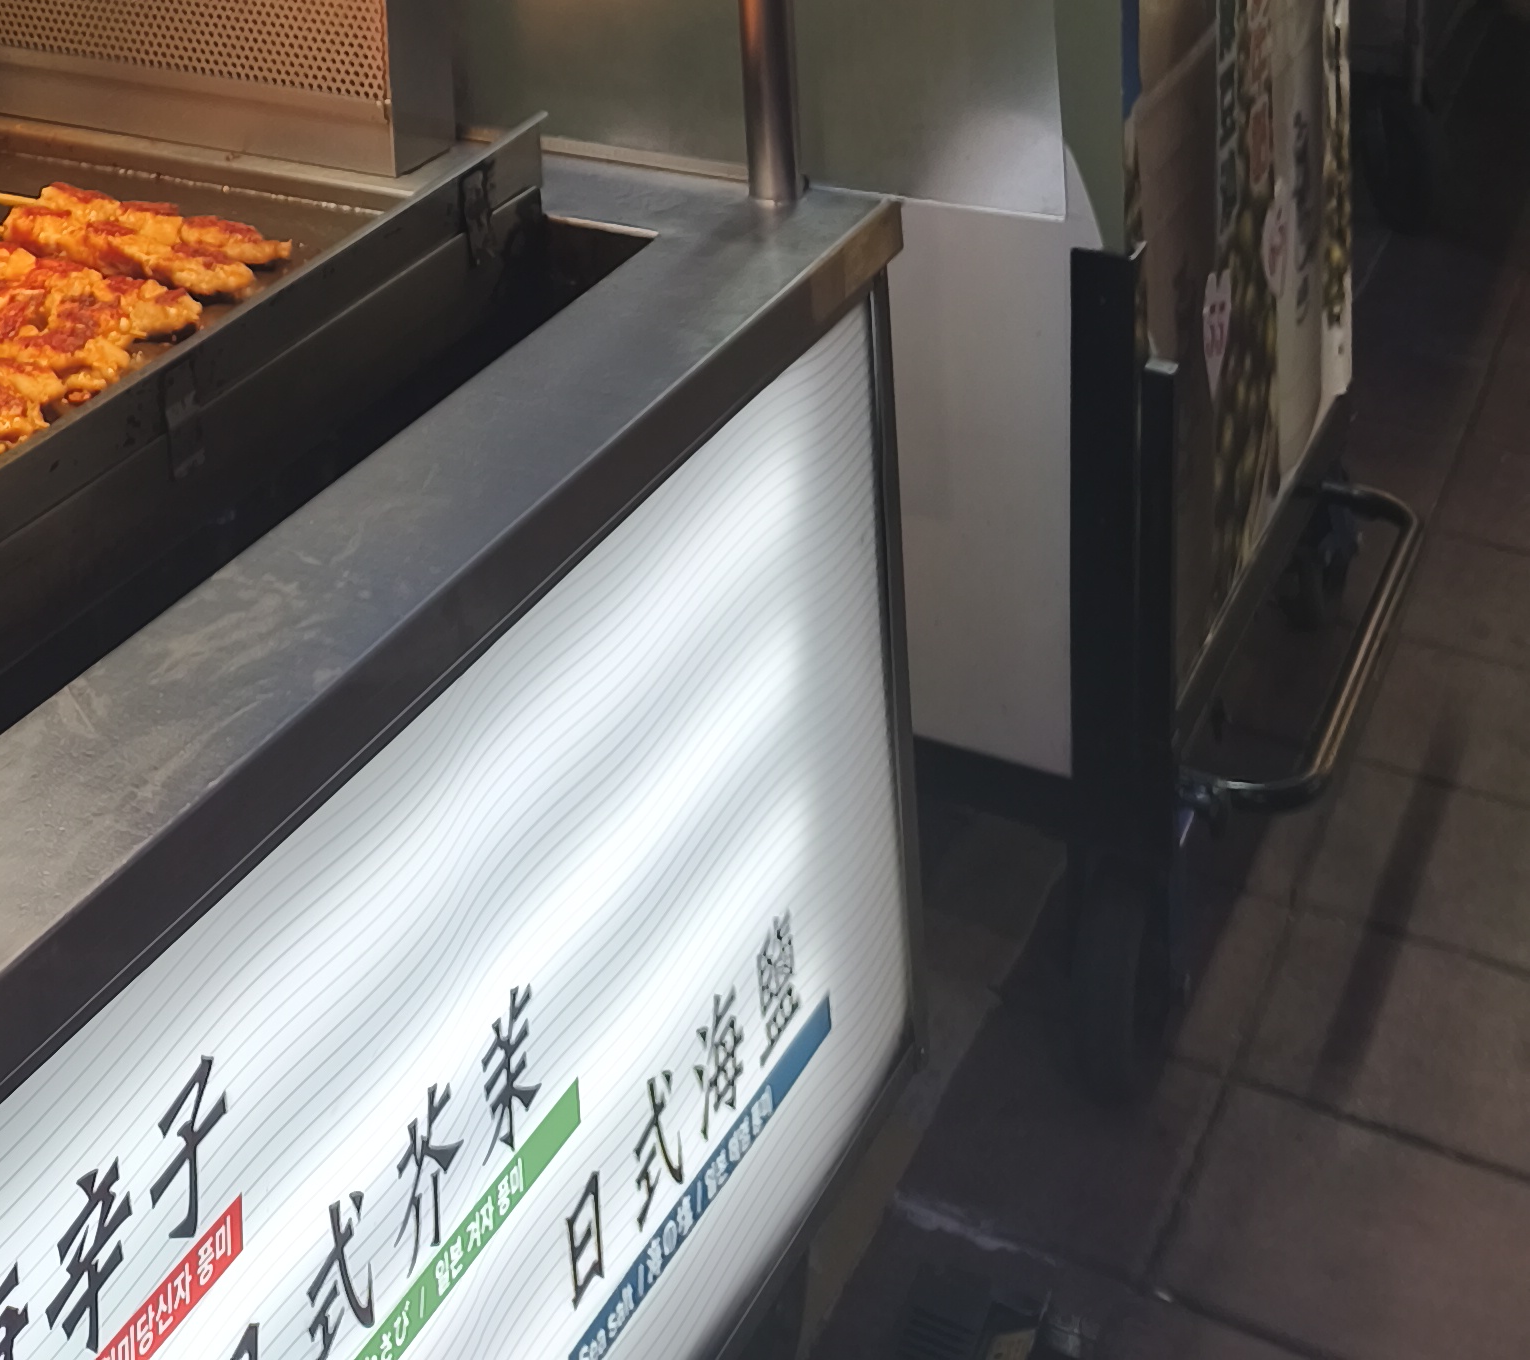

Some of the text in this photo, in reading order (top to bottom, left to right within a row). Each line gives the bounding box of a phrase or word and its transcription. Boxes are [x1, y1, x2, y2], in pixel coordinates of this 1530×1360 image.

[565, 910, 800, 1312] 日式海鹽
[104, 1214, 232, 1360] 미당신자 풍미
[364, 1300, 412, 1360] さび
[434, 1236, 465, 1297] 일본
[496, 1157, 525, 1217] 풍미
